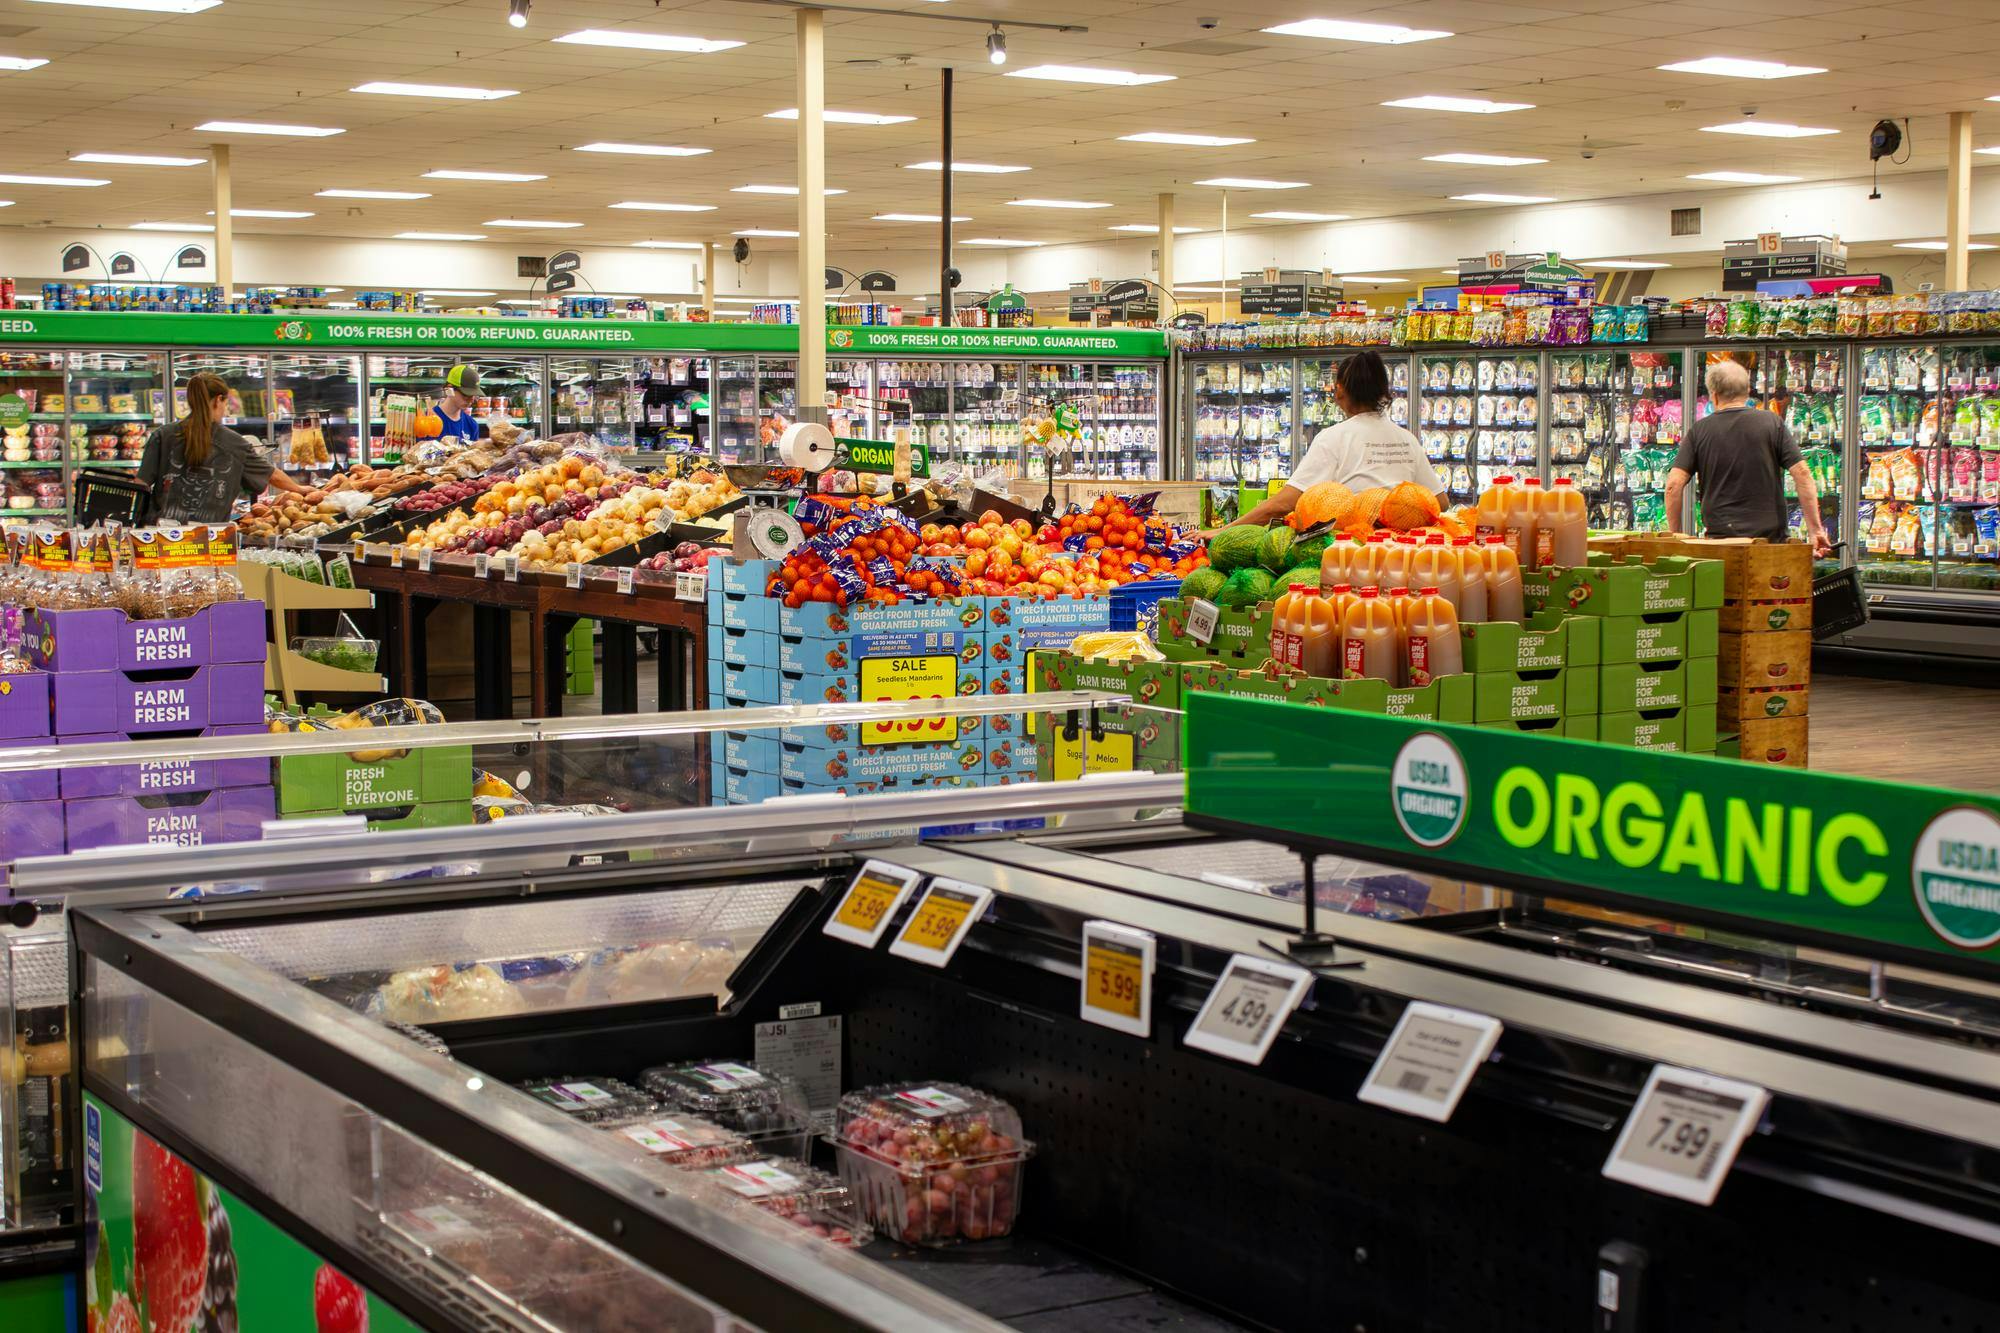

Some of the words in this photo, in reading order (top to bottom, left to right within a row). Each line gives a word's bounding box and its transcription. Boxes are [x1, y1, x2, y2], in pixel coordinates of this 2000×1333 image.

[1760, 236, 1777, 252] 15
[1488, 253, 1503, 268] 16
[1266, 269, 1277, 283] 17
[1527, 270, 1548, 279] peanut
[1548, 272, 1567, 281] butter
[1090, 280, 1100, 293] 18
[1109, 292, 1124, 302] instant
[1124, 287, 1145, 300] potatoes
[327, 325, 365, 338] 100%
[367, 326, 413, 339] FRESH
[416, 326, 438, 339] OR
[441, 326, 477, 340] 100%
[480, 327, 539, 340] REFUND.
[542, 328, 635, 342] GUARANTEED.
[868, 333, 898, 345] 100%
[901, 334, 938, 346] FRESH
[941, 335, 959, 347] OR
[961, 335, 990, 347] 100%
[993, 336, 1041, 347] REFUND.
[1043, 337, 1119, 349] GUARANTEED.
[852, 446, 895, 466] ORGAN
[1644, 579, 1669, 590] FRESH
[1644, 590, 1661, 600] FOR
[1015, 606, 1044, 615] DIRECT
[1046, 604, 1070, 614] FROM
[1072, 604, 1087, 612] THE
[1643, 598, 1686, 610] EVERYONE.
[853, 612, 886, 621] DIRECT
[886, 610, 912, 620] FROM
[913, 609, 929, 618] THE
[931, 608, 956, 617] FARM.
[1023, 614, 1077, 624] GUARANTEED
[1078, 613, 1105, 622] FRESH.
[861, 620, 919, 631] GUARANTEED
[920, 619, 949, 628] FRESH.
[1193, 618, 1209, 631] 4.99
[1226, 624, 1253, 637] FRESH
[136, 626, 186, 644] FARM
[1636, 628, 1662, 639] FRESH
[27, 634, 39, 650] YOU
[1518, 636, 1545, 647] FRESH
[1636, 639, 1654, 649] FOR
[136, 643, 192, 662] FRESH
[1347, 647, 1361, 655] APPLE
[1518, 647, 1536, 657] FOR
[1636, 647, 1679, 659] EVERYONE.
[892, 659, 927, 672] SALE
[1517, 655, 1564, 668] EVERYONE.
[908, 674, 944, 682] Mandarins
[1076, 674, 1099, 688] FARM
[1101, 677, 1127, 690] FRESH
[1635, 676, 1661, 687] FRESH
[134, 688, 185, 706] FARM
[1511, 685, 1538, 697] FRESH
[1635, 687, 1653, 697] FOR
[1386, 694, 1415, 706] FRESH
[1511, 696, 1530, 707] FOR
[1635, 695, 1678, 708] EVERYONE.
[135, 706, 190, 724] FRESH
[1386, 705, 1405, 715] FOR
[1511, 704, 1559, 717] EVERYONE.
[1635, 724, 1660, 735] FRESH
[1635, 734, 1652, 746] FOR
[853, 757, 885, 767] DIRECT
[886, 754, 912, 764] FROM
[913, 753, 929, 762] THE
[929, 752, 955, 762] FARM.
[1096, 754, 1119, 764] Melon
[346, 767, 385, 781] FRESH
[861, 764, 918, 776] GUARANTEED
[920, 762, 948, 772] FRESH.
[1409, 759, 1451, 788] USDA
[140, 769, 196, 789] FRESH
[346, 780, 372, 793] FOR
[1402, 792, 1457, 820] ORGANIC
[147, 814, 197, 833] FARM
[855, 829, 885, 840] DIRECT
[888, 827, 912, 837] FROM
[1492, 765, 1889, 907] ORGANIC
[1938, 839, 2000, 872] USDA
[852, 895, 886, 921] 5.99
[920, 913, 955, 938] 5.99
[1101, 970, 1134, 1001] 5.99
[1222, 996, 1266, 1029] 4.99
[769, 1024, 787, 1036] JSI
[1647, 1117, 1711, 1158] 7.99
